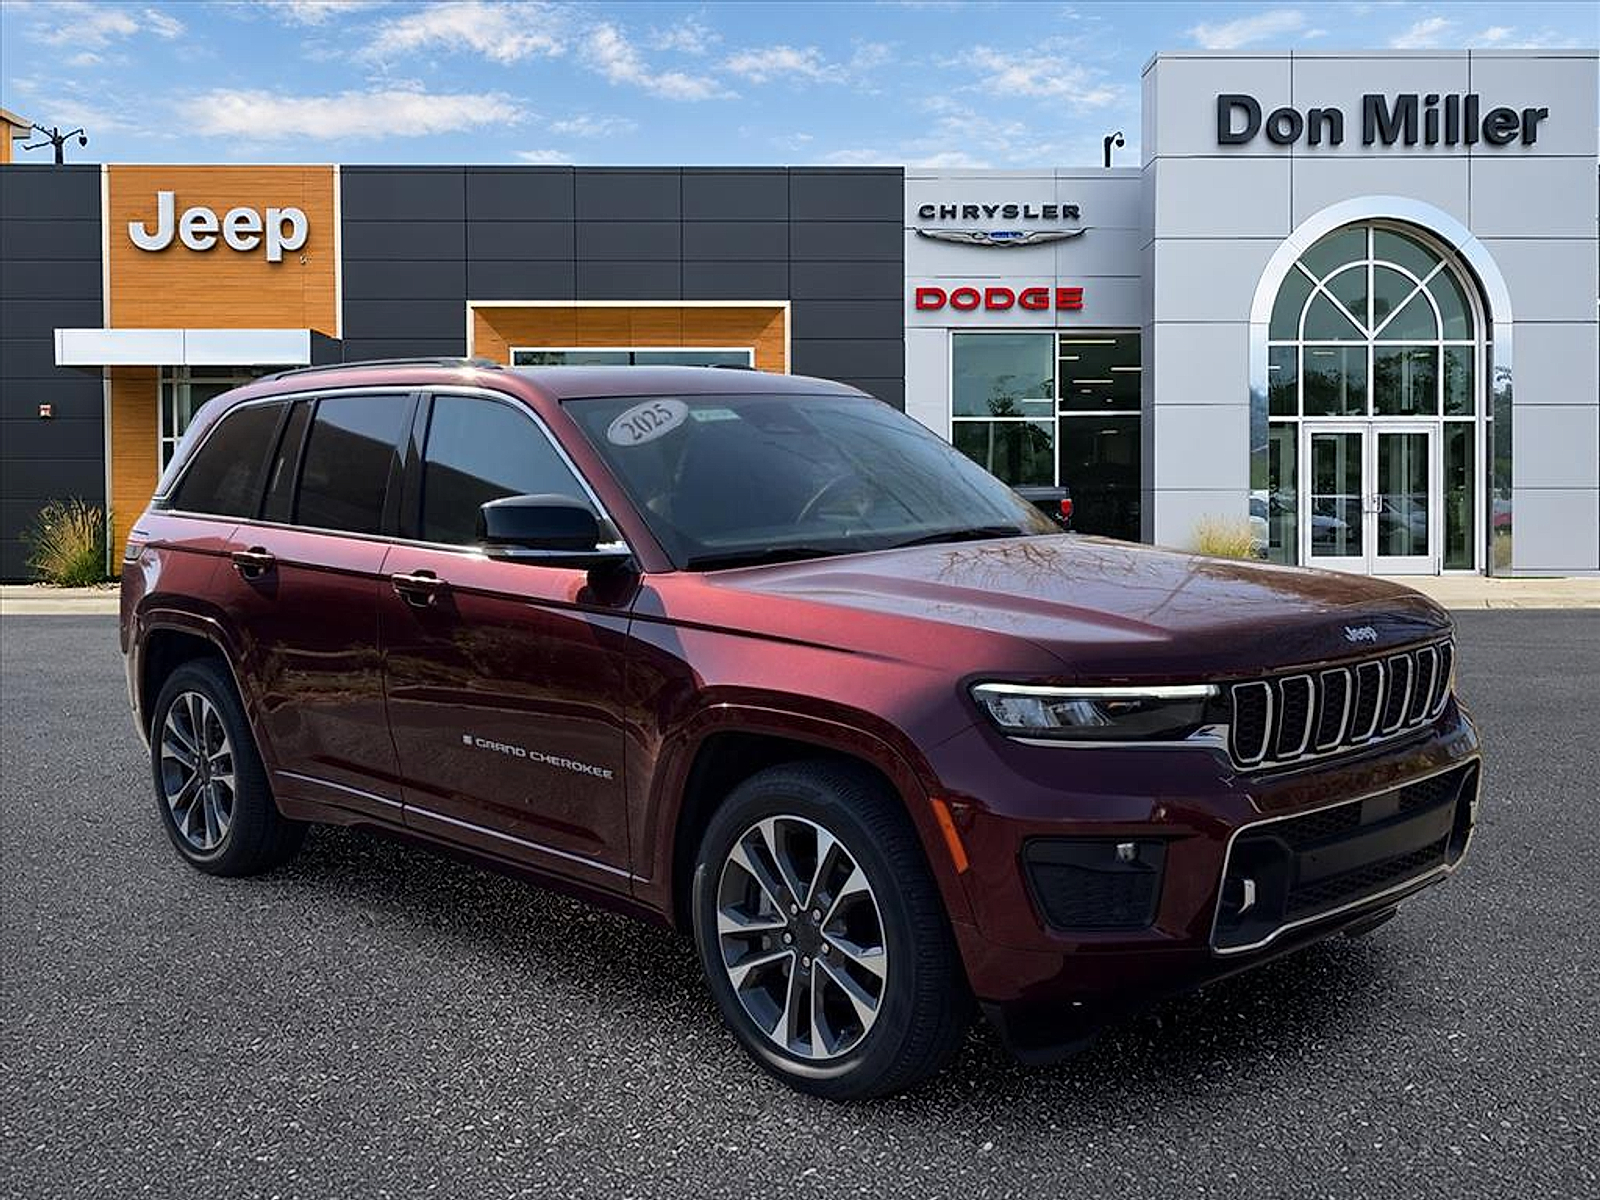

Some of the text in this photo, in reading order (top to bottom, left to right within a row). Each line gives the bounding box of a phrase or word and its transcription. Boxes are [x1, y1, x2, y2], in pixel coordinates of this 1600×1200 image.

[1217, 94, 1549, 146] Don Miller
[128, 190, 309, 262] Jeep
[918, 204, 1081, 220] CHRYSLER
[915, 287, 1084, 311] DODGE
[621, 403, 674, 441] 2025
[1343, 626, 1378, 642] Jeep
[475, 738, 614, 780] GRAND CHEROKEE
